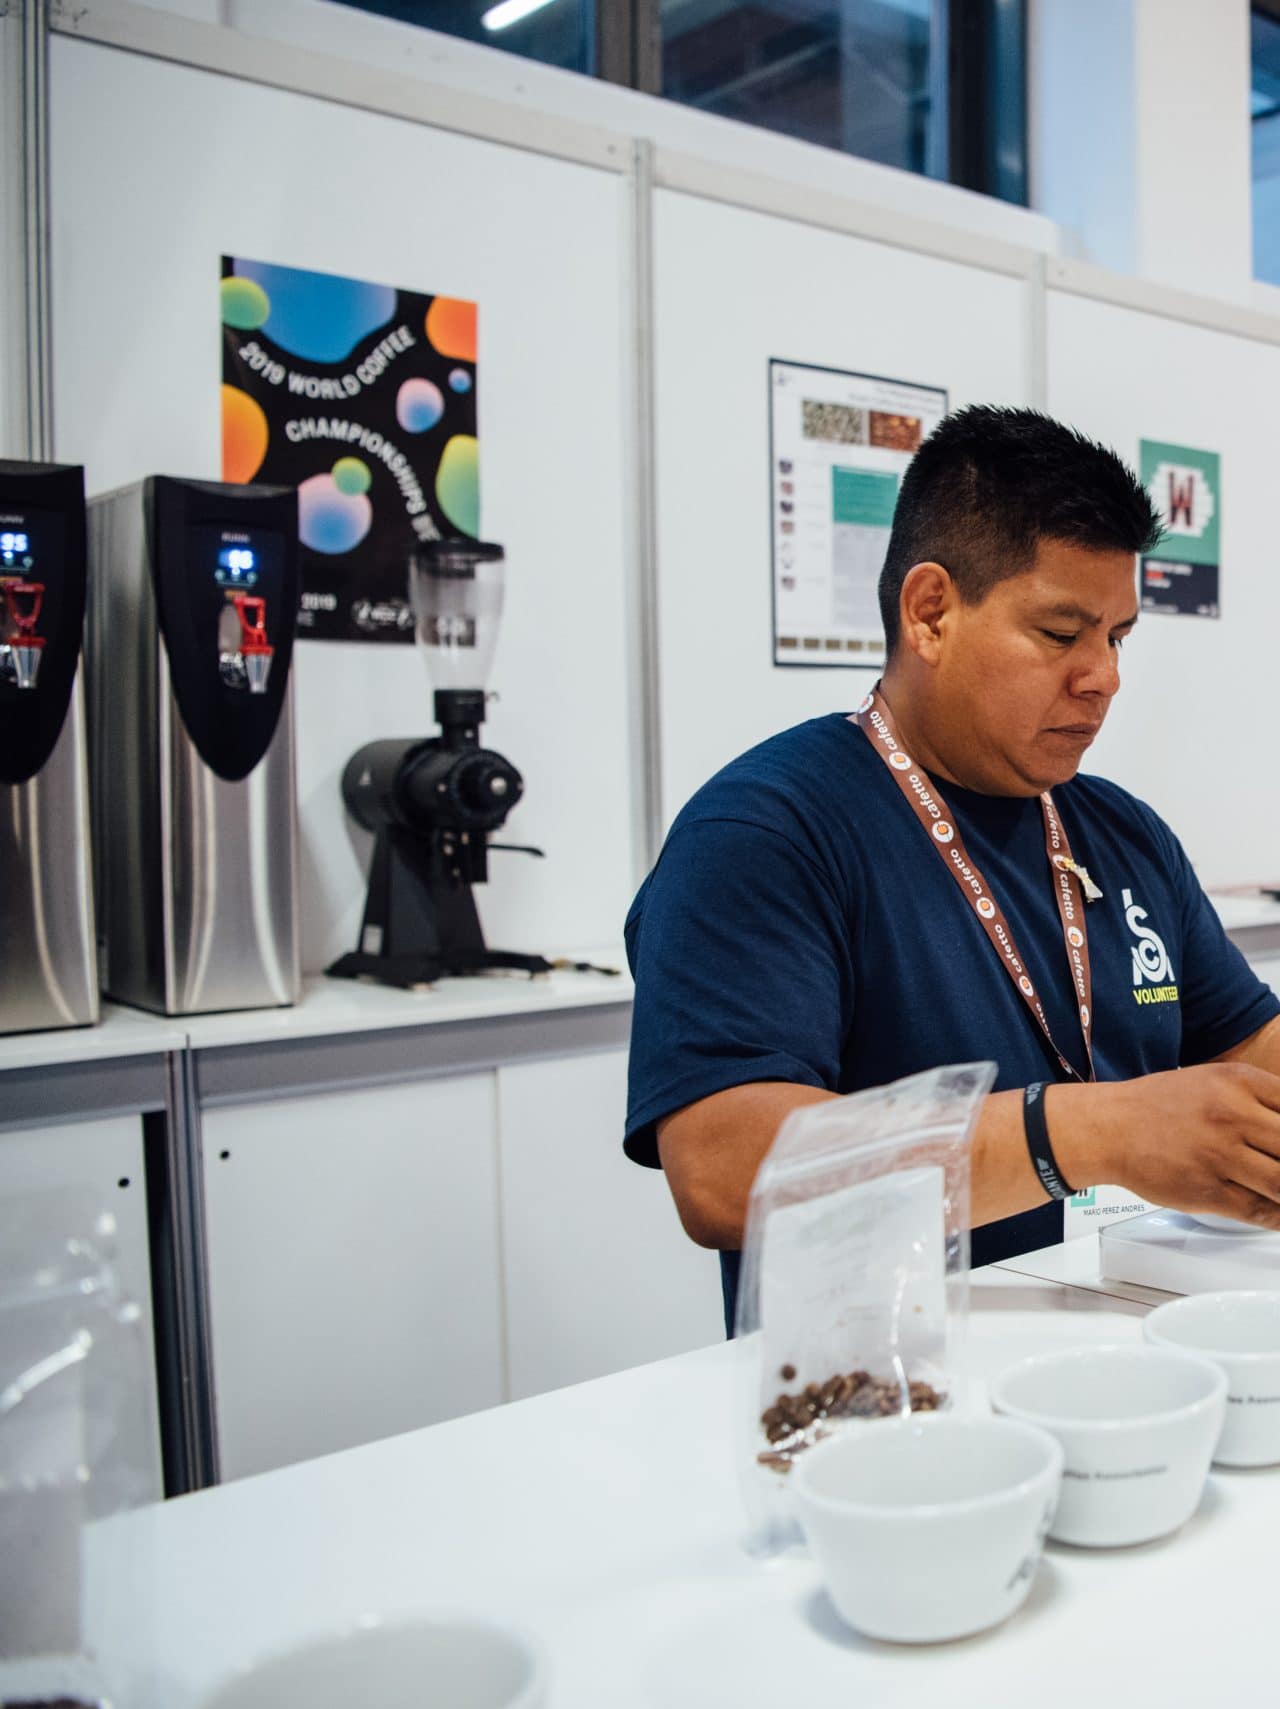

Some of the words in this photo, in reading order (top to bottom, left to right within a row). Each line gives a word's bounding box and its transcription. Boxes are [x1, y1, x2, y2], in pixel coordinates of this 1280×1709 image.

[239, 341, 286, 385] 2019
[288, 371, 361, 400] WORLD
[356, 325, 416, 385] COFFEE
[285, 417, 427, 515] CHAMPIONSHIPS
[870, 711, 897, 750] cafetto
[909, 775, 941, 818] cafetto
[950, 849, 982, 894] cafetto
[1060, 873, 1075, 920] cafetto
[995, 924, 1022, 973] cafetto
[1072, 950, 1086, 998] cafetto
[1133, 986, 1179, 1006] VOLUNTEE
[1102, 1206, 1119, 1215] PEREZ
[1121, 1204, 1145, 1213] ANDRES
